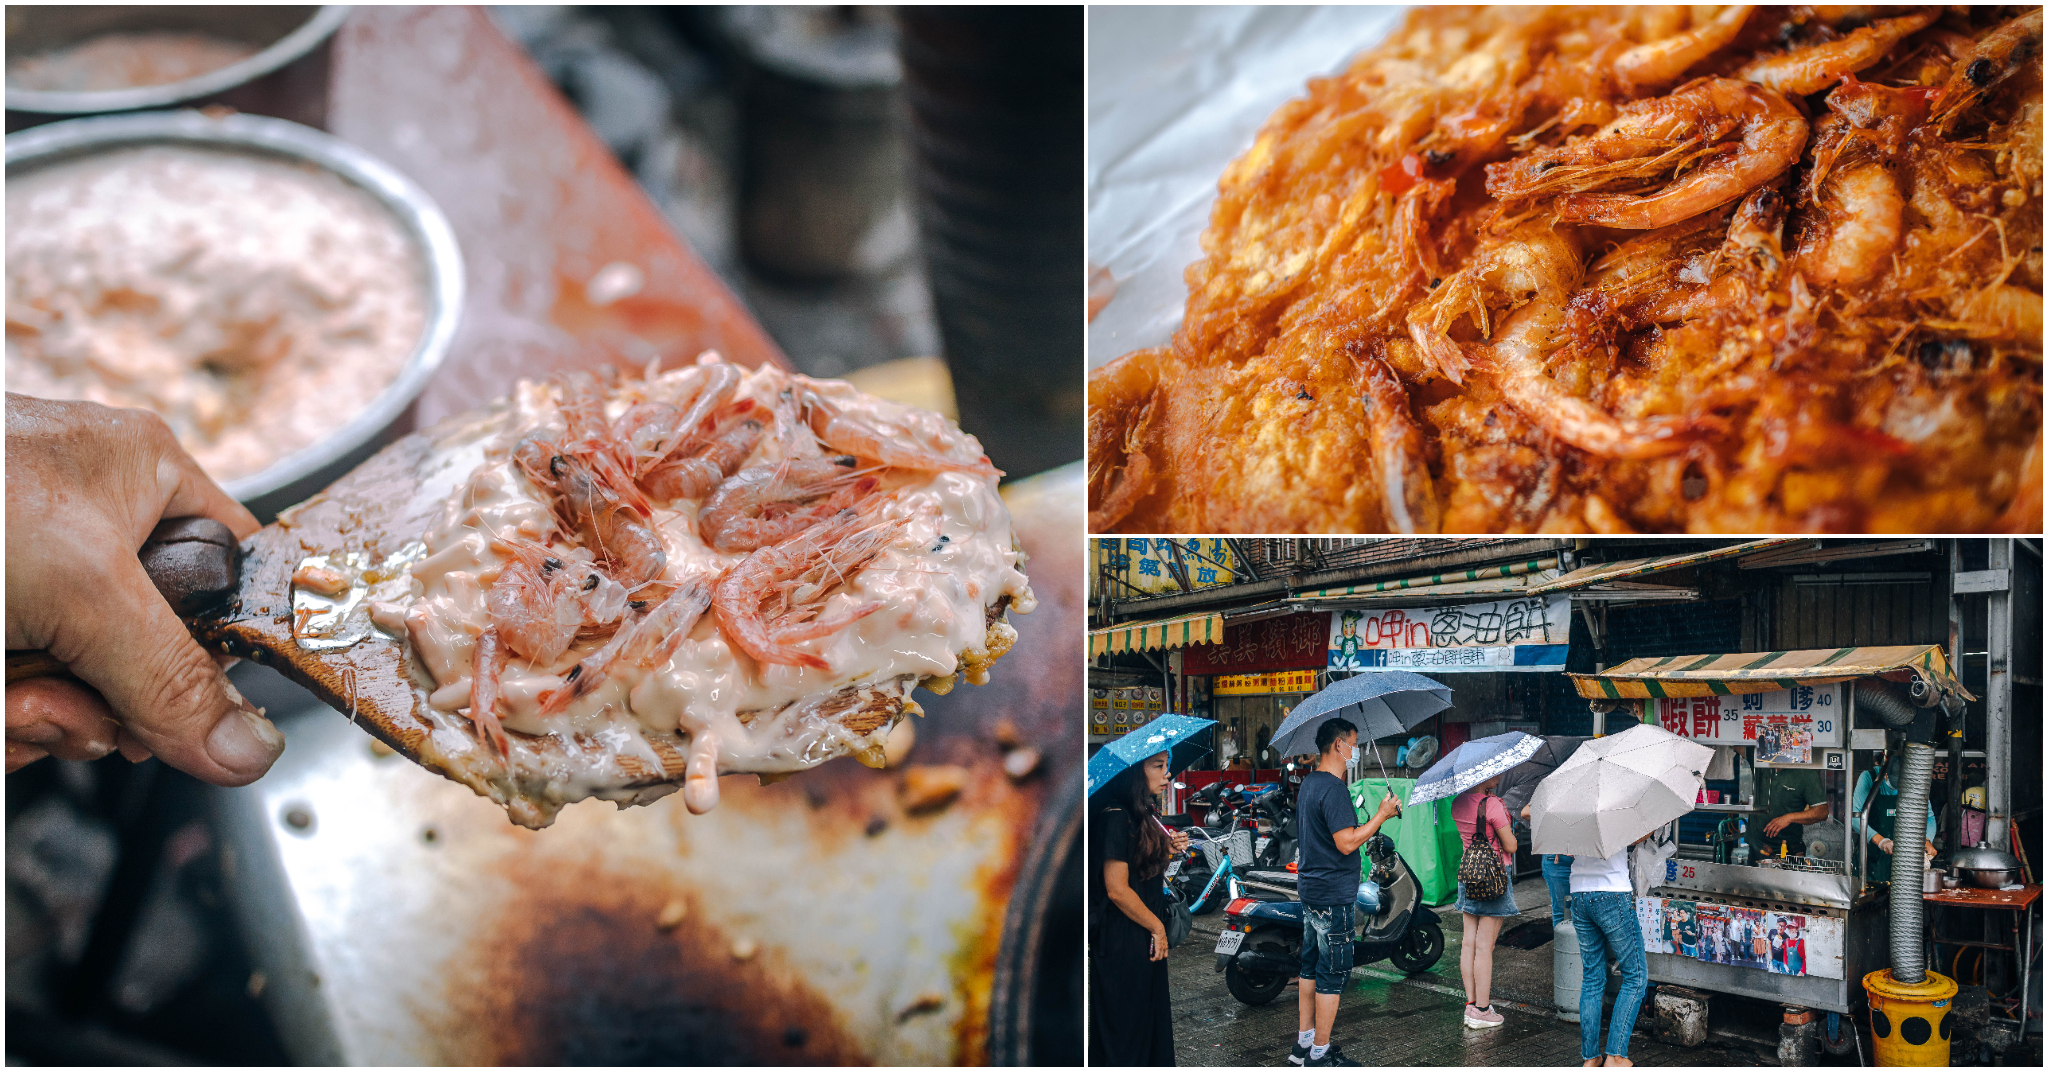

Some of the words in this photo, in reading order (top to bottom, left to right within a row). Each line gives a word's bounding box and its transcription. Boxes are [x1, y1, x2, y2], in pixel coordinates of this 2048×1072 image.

[1817, 694, 1832, 707] 40
[1723, 709, 1739, 721] 35
[1817, 720, 1832, 733] 30
[1682, 866, 1695, 879] 25
